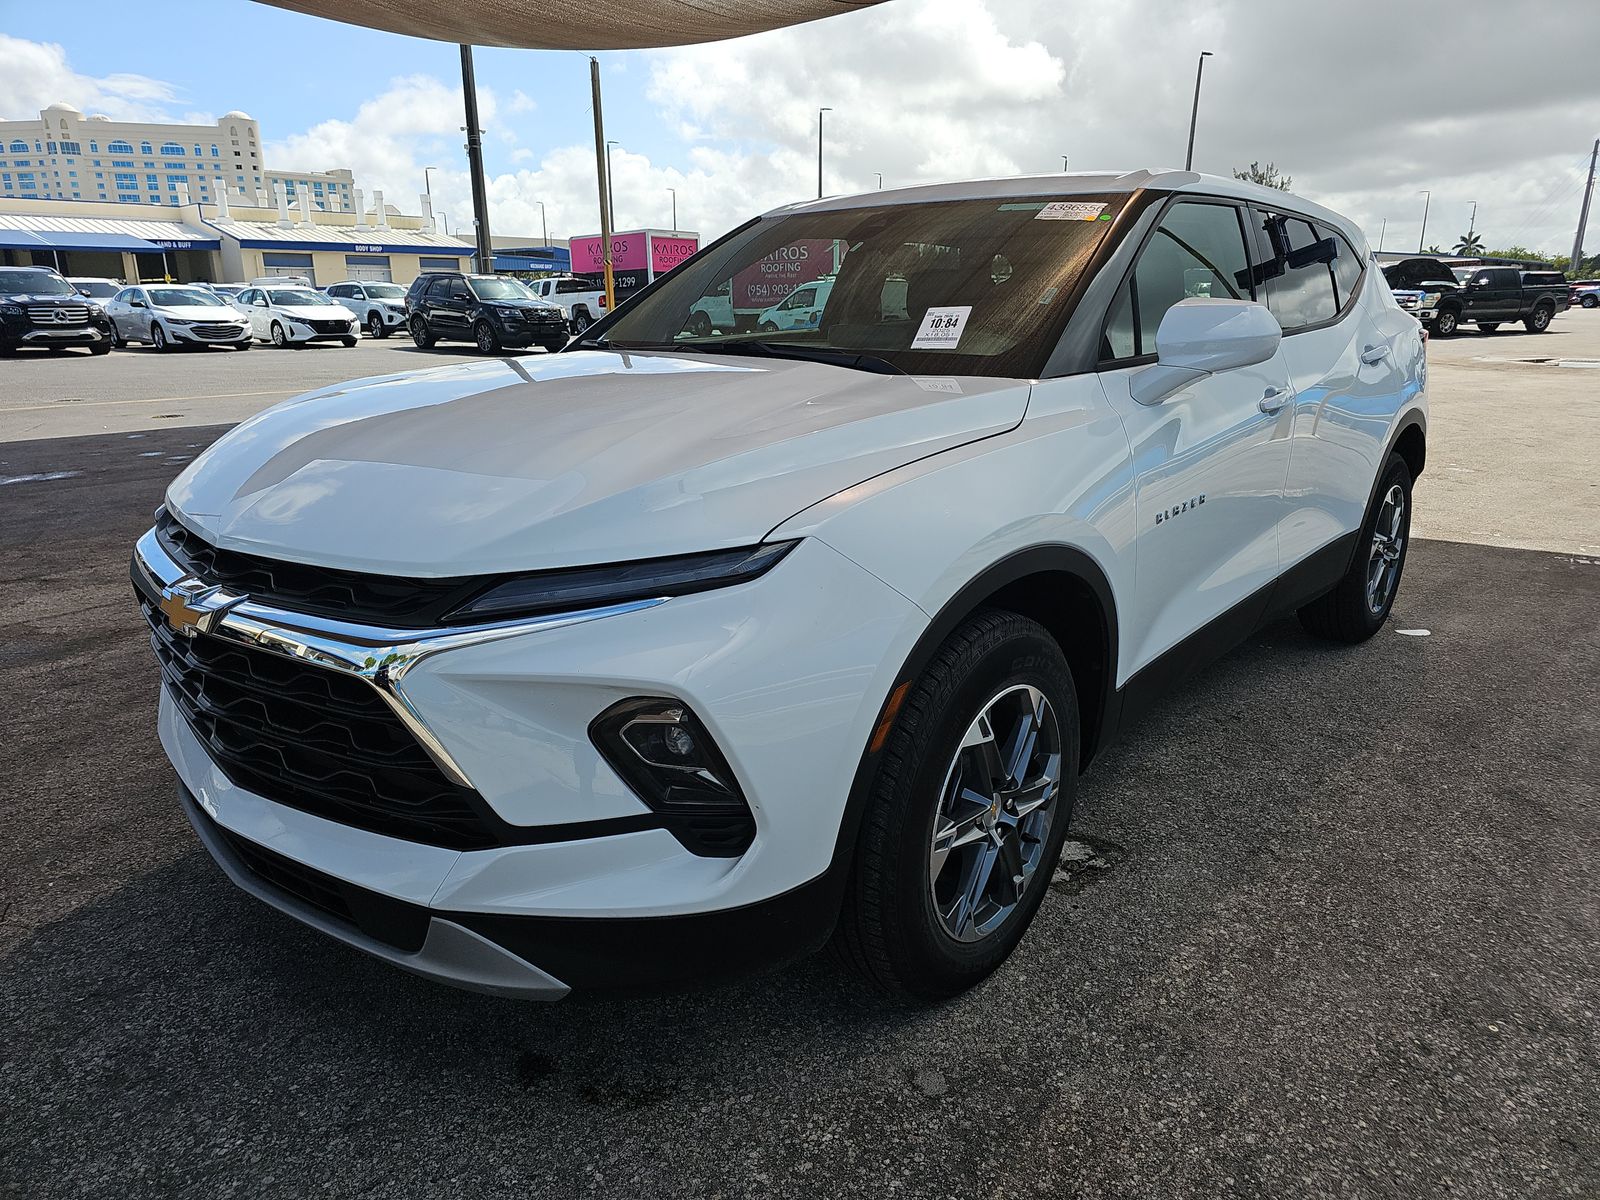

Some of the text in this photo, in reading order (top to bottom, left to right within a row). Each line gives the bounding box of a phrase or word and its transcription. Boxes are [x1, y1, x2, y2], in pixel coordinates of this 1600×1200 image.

[587, 240, 628, 255] KAOS
[653, 243, 694, 256] KAIROS
[761, 262, 801, 273] ROOFING
[747, 284, 770, 297] (954)
[930, 317, 959, 329] 10:84
[1155, 494, 1206, 525] BLAZER
